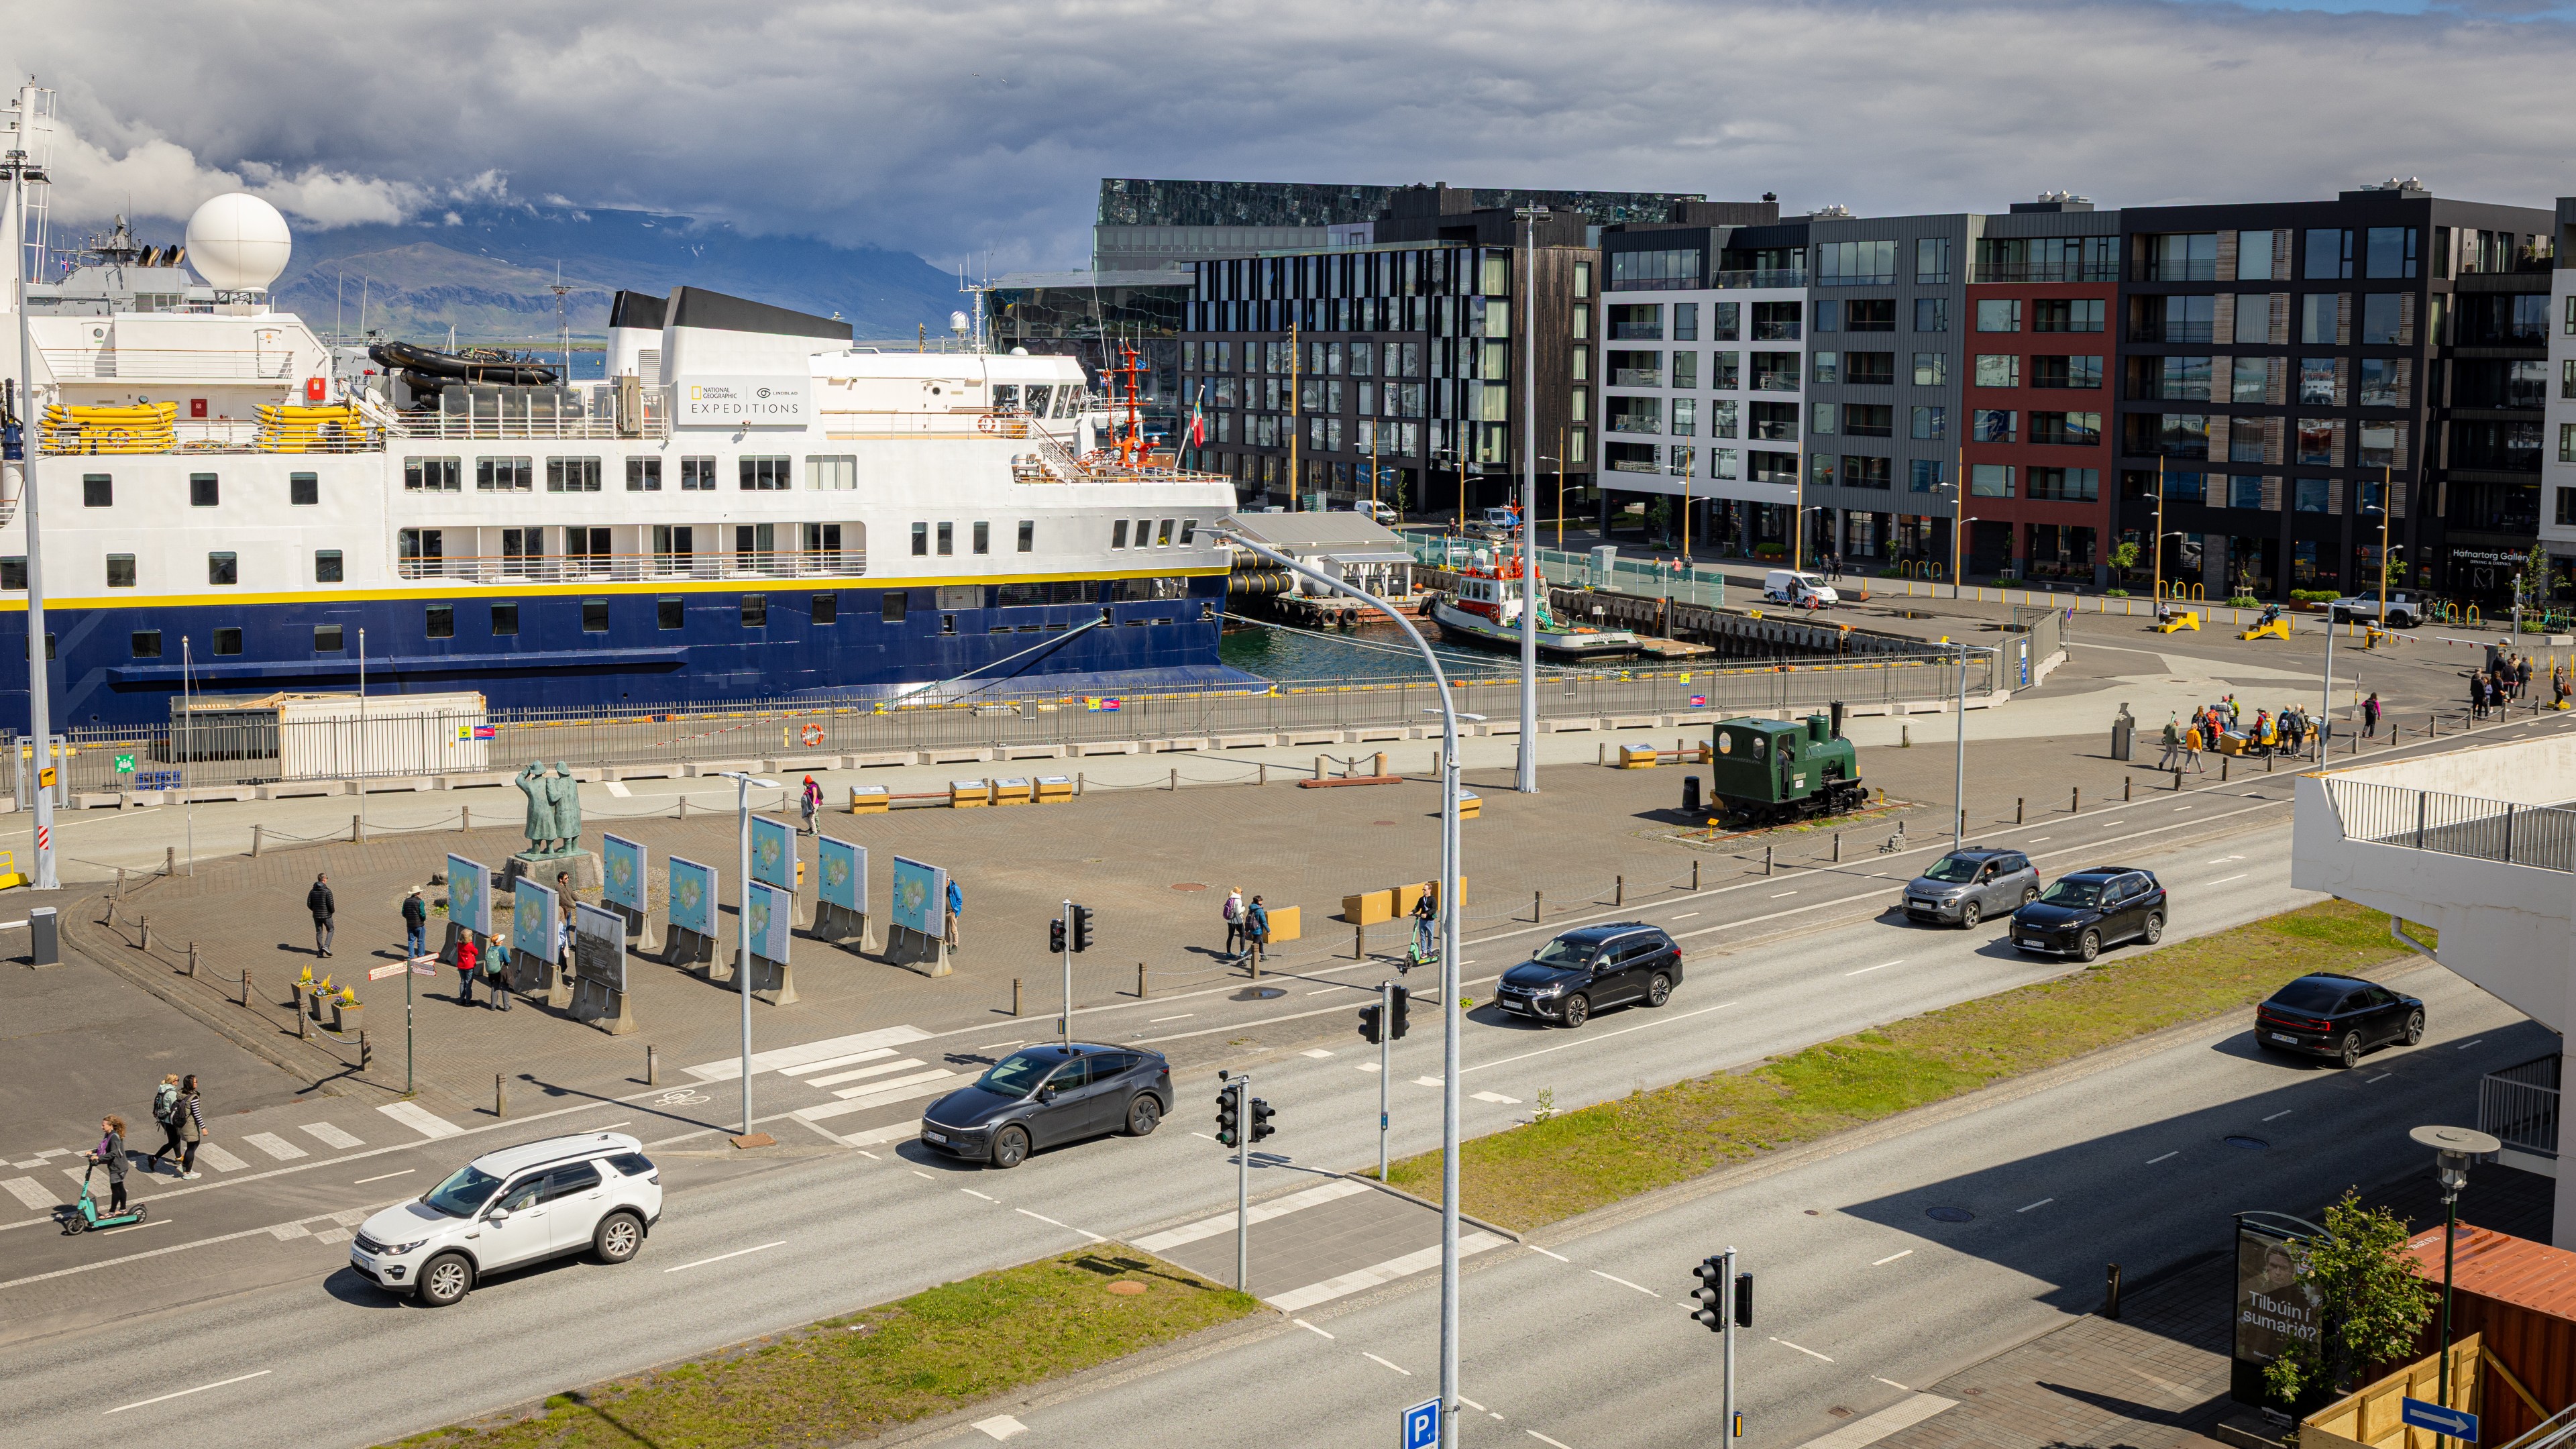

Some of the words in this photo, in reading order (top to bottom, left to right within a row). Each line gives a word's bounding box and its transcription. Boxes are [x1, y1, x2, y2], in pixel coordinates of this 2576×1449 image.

[692, 404, 798, 413] EXPEDITIONS
[2453, 549, 2498, 561] Hafnartorg
[2500, 552, 2530, 563] Gallery
[360, 1228, 382, 1242] DISCOVERY
[2249, 1290, 2302, 1320] Tilbúin
[2306, 1307, 2311, 1322] í
[2243, 1310, 2316, 1342] sumarið?
[1415, 1414, 1430, 1442] P
